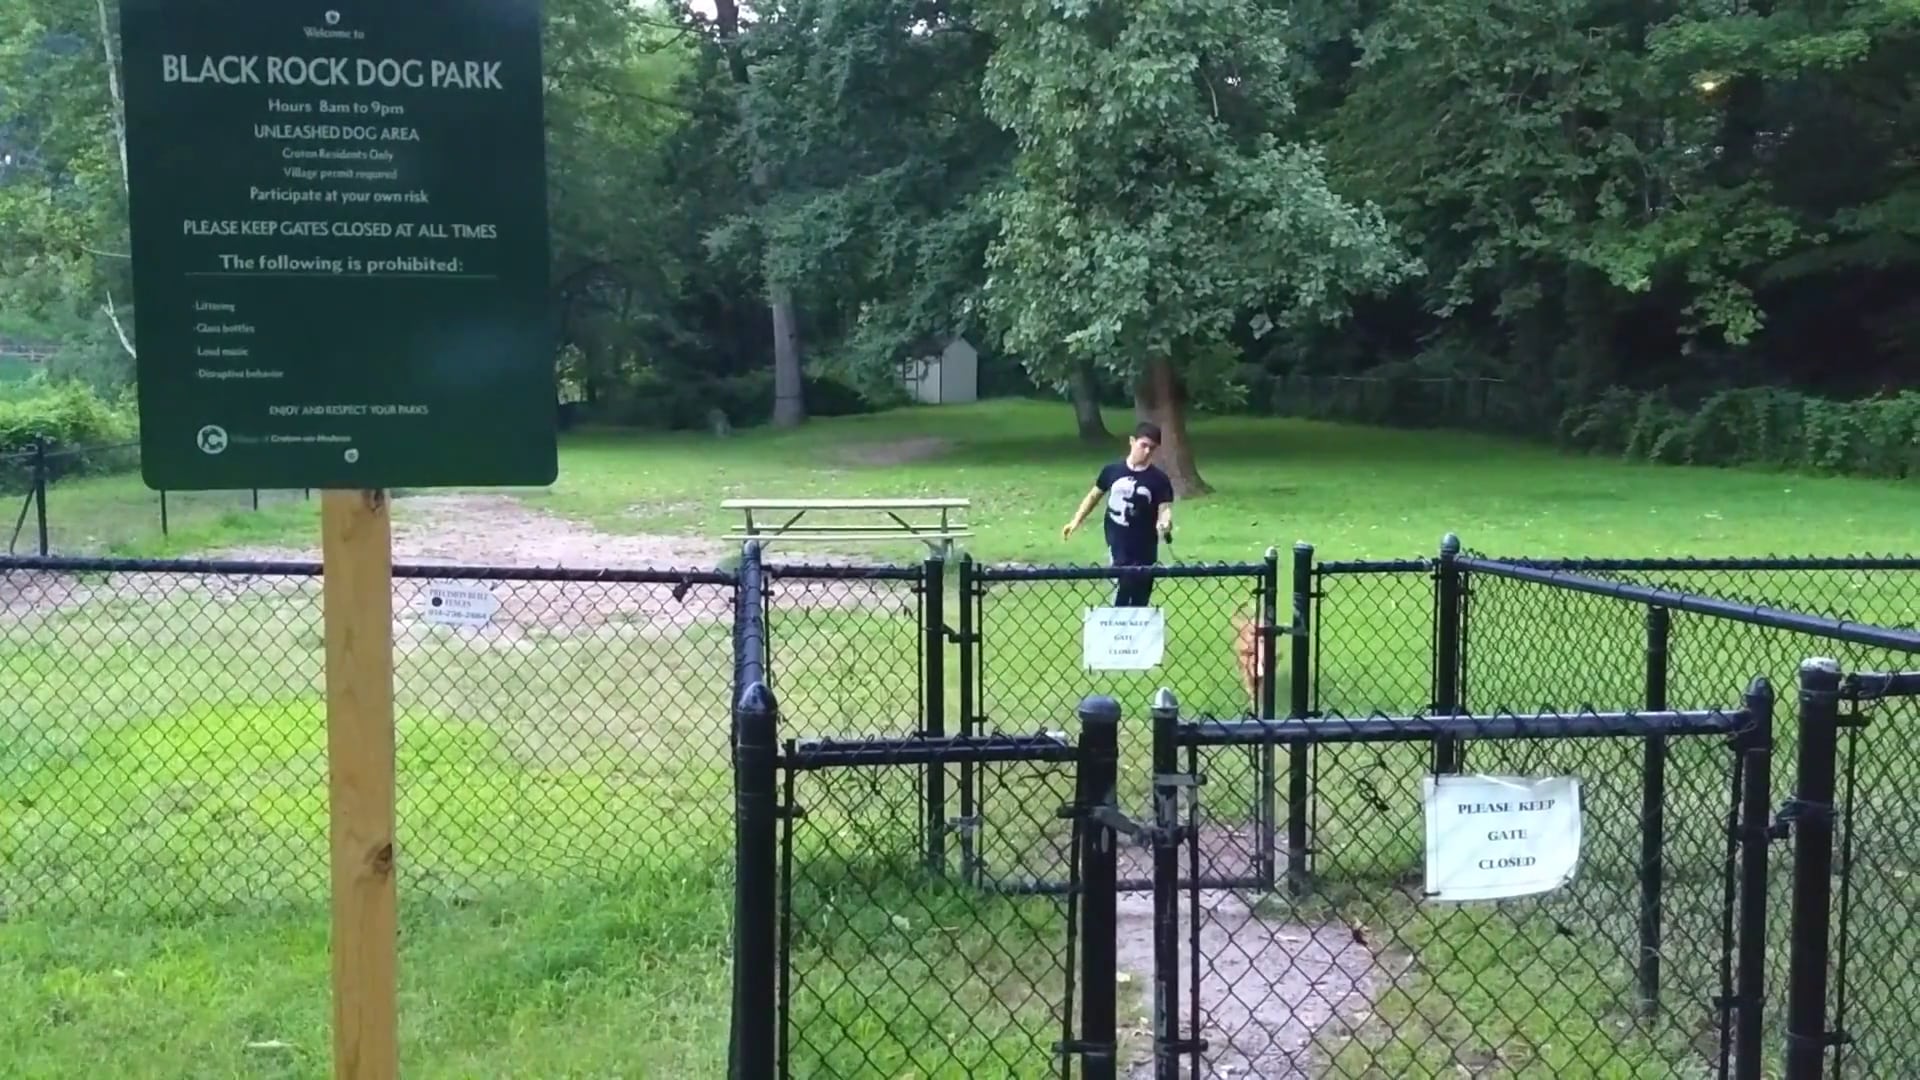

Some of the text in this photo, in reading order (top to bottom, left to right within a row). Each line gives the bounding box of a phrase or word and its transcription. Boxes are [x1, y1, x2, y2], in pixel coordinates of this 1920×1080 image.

[304, 26, 365, 39] Welcome to
[162, 54, 503, 89] BLACK ROCK DOG PARK
[268, 99, 404, 117] Hours 8am to 9pm
[254, 124, 419, 142] UNLEASHED DOG AREA
[282, 147, 393, 162] Croton Residents Only
[283, 167, 397, 182] Village permit required
[250, 187, 428, 204] Participate at your own risk
[184, 220, 497, 239] PLEASE KEEP GATES CLOSED AT ALL TIMES
[219, 254, 463, 274] The following is prohibited:
[222, 323, 255, 334] bottles
[197, 346, 220, 356] Loud
[246, 368, 283, 379] behavior
[269, 405, 429, 416] ENJOY AND RESPECT YOUR PARKS
[1457, 799, 1556, 815] PLEASE KEEP
[1487, 829, 1528, 842] GATE
[1478, 856, 1537, 870] CLOSED
